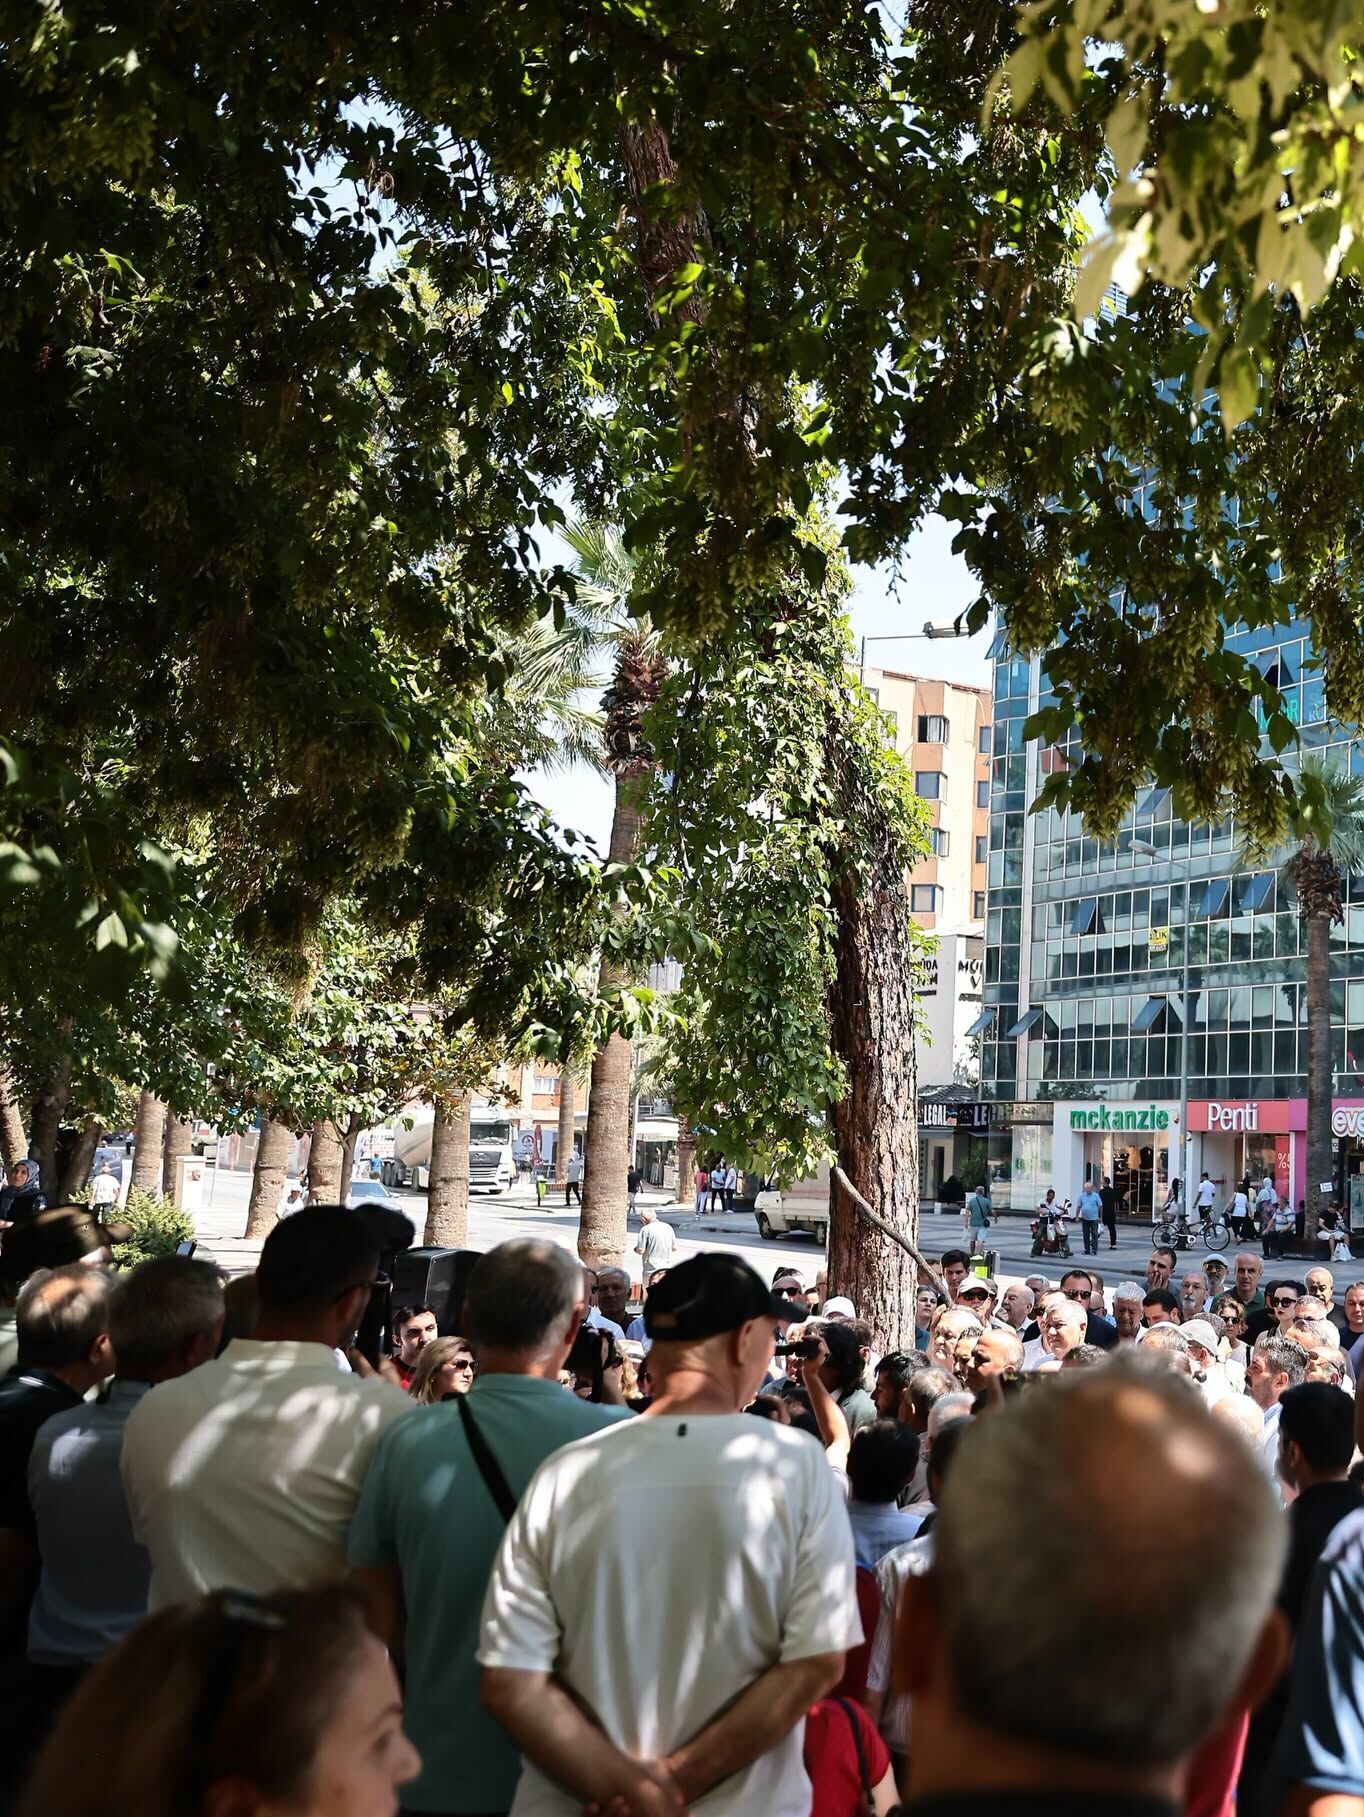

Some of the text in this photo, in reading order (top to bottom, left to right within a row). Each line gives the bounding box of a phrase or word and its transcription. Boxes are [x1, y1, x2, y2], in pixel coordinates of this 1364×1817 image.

[923, 1104, 947, 1126] LEGAL
[1069, 1104, 1170, 1130] mckanzie
[1207, 1102, 1259, 1131] Penti
